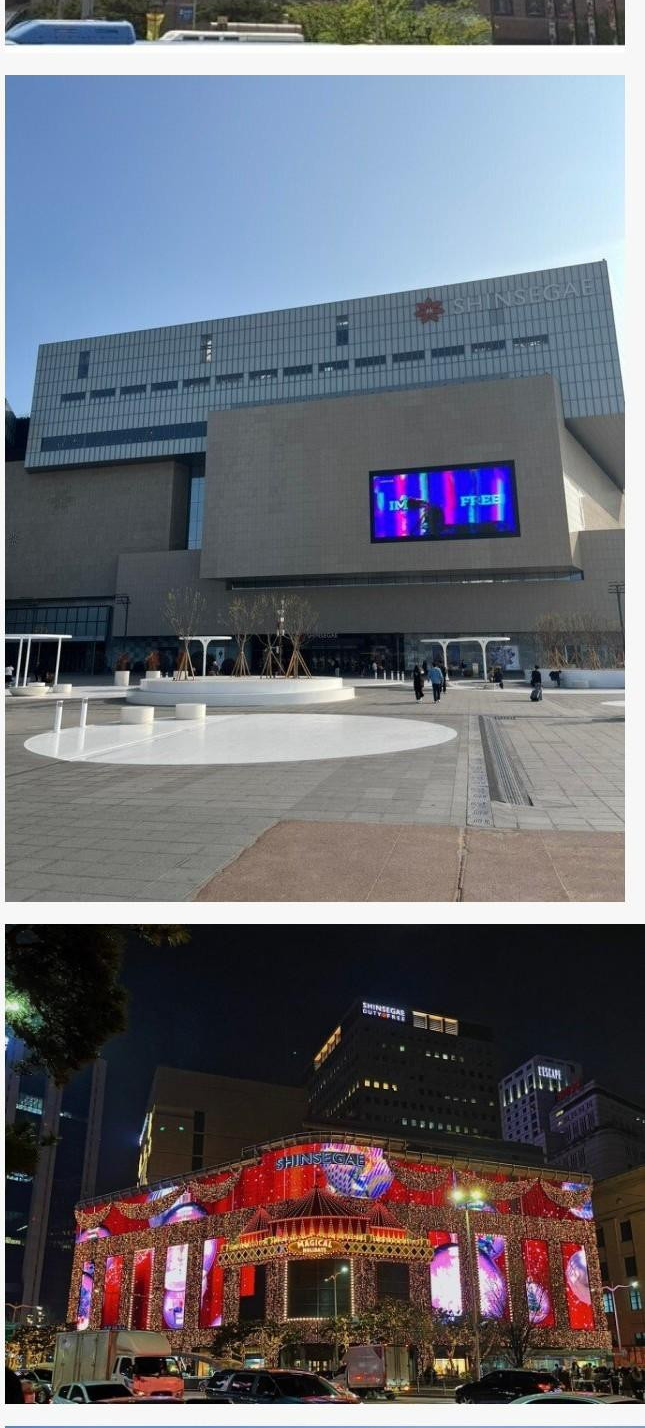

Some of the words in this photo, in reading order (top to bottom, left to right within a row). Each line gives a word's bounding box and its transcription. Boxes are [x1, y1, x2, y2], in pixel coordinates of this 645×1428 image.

[453, 278, 596, 315] SHINSEGAE
[362, 1001, 405, 1016] SHINSEGAE
[362, 1009, 381, 1018] DUTY
[387, 1013, 405, 1022] FREE
[275, 1152, 366, 1171] SHINSEGAE
[297, 1240, 333, 1249] MAGICAL
